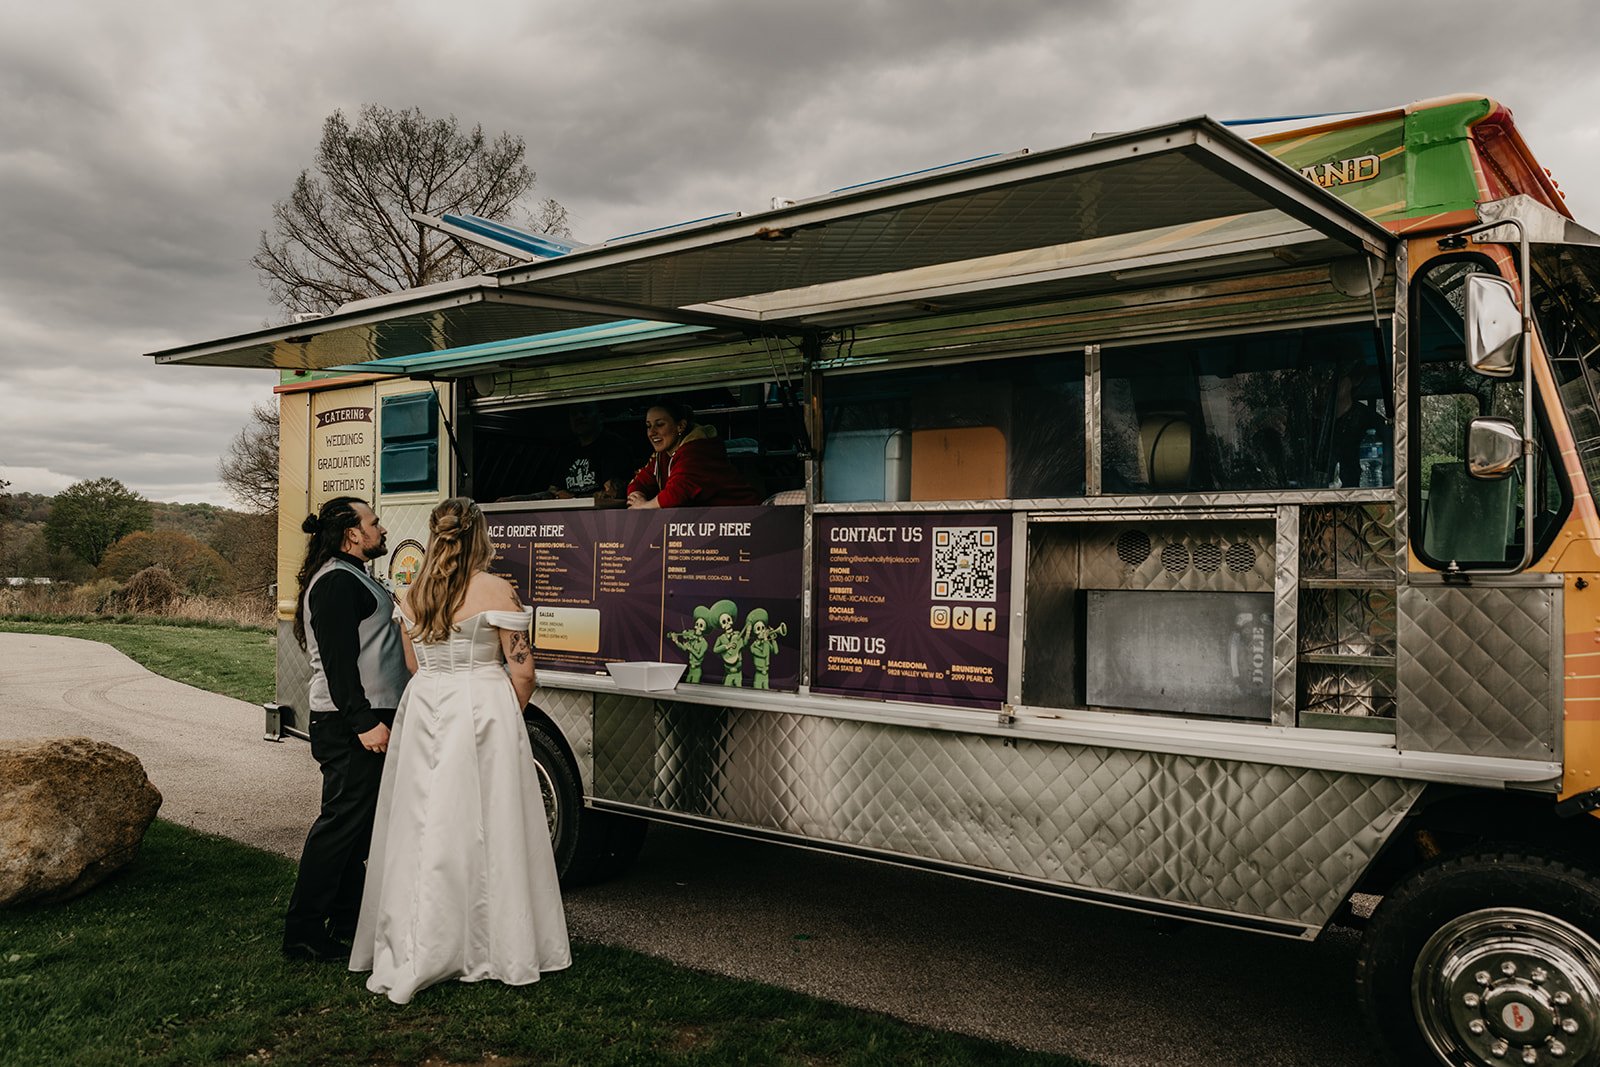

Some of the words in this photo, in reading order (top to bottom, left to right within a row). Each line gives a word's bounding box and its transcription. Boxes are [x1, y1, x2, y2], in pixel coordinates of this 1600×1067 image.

[324, 409, 365, 423] CATERING
[325, 432, 364, 447] WEDDINGS
[317, 455, 371, 470] GRADUATIONS
[322, 478, 365, 492] BIRTHDAYS
[487, 525, 504, 537] ACE
[507, 525, 537, 537] ORDER
[539, 525, 565, 537] HERE
[669, 523, 696, 537] PICK
[698, 523, 716, 537] UP
[719, 522, 751, 537] HERE
[830, 527, 897, 542] CONTACT
[901, 527, 923, 542] US
[828, 606, 855, 614] SOCIALS
[828, 634, 861, 653] FIND
[864, 637, 886, 654] US
[827, 656, 862, 665] CUYAHOGA
[863, 658, 881, 666] FALLS
[1253, 627, 1264, 684] DOLE
[887, 660, 927, 670] MACEDONIA
[951, 664, 993, 675] BRUNSWICK
[900, 669, 919, 678] VALLEY
[921, 671, 935, 679] VIEW
[966, 674, 984, 683] PEARL
[984, 676, 994, 684] RD
